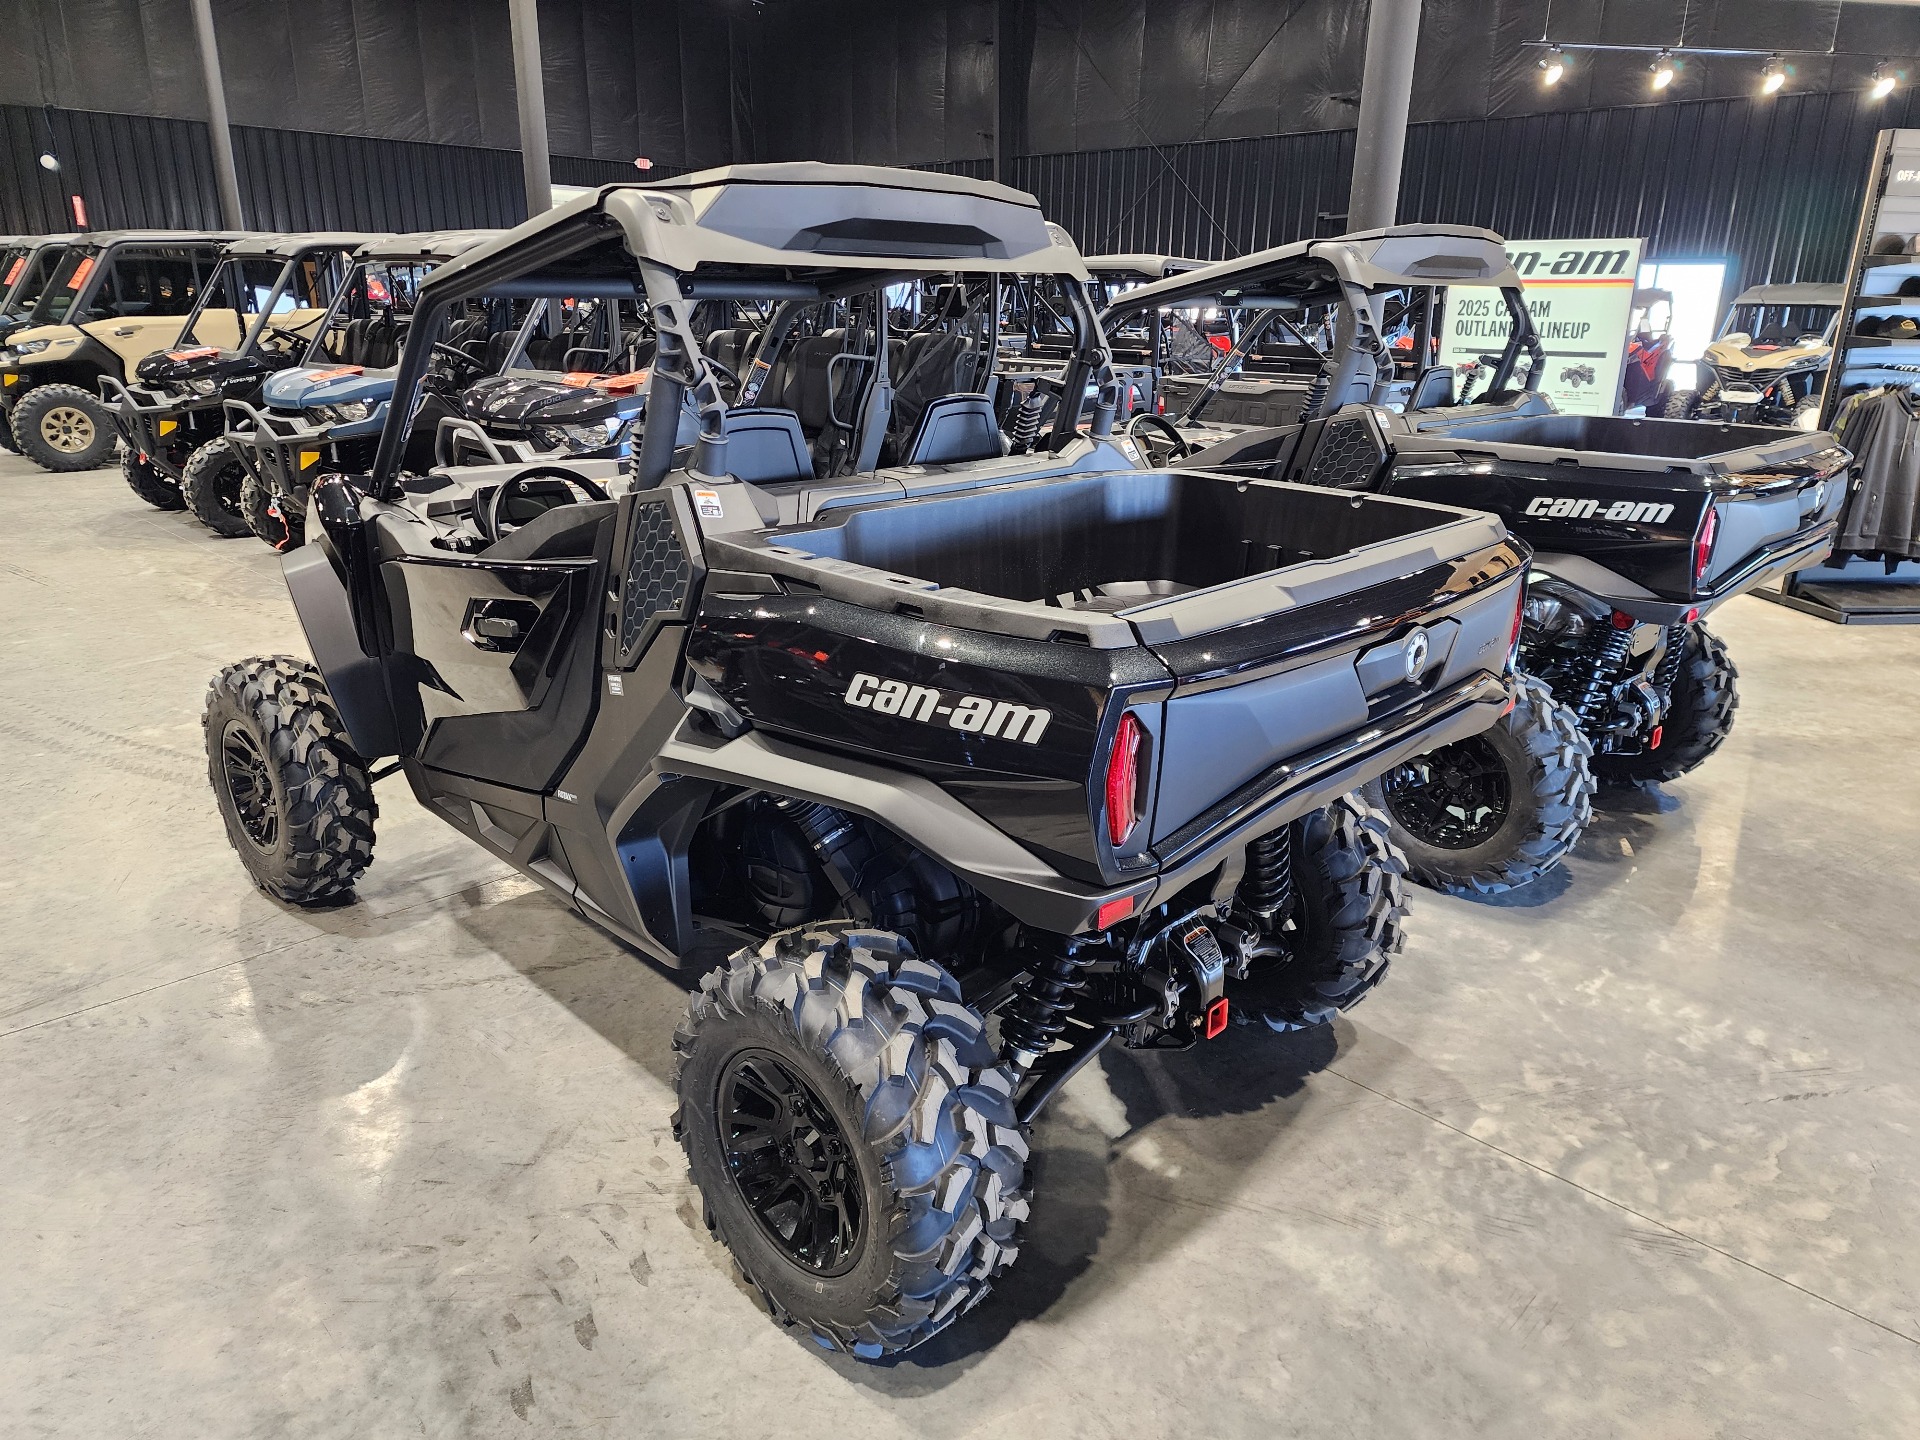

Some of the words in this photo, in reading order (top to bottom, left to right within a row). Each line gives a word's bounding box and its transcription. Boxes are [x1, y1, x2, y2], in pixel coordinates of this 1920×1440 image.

[1505, 249, 1631, 276] n-am
[1457, 299, 1490, 317] 2025
[1455, 319, 1514, 338] OUTLAN
[1539, 322, 1591, 339] LINEUP
[539, 395, 562, 407] HD10
[1525, 496, 1675, 524] can-am
[844, 671, 1052, 745] can-am
